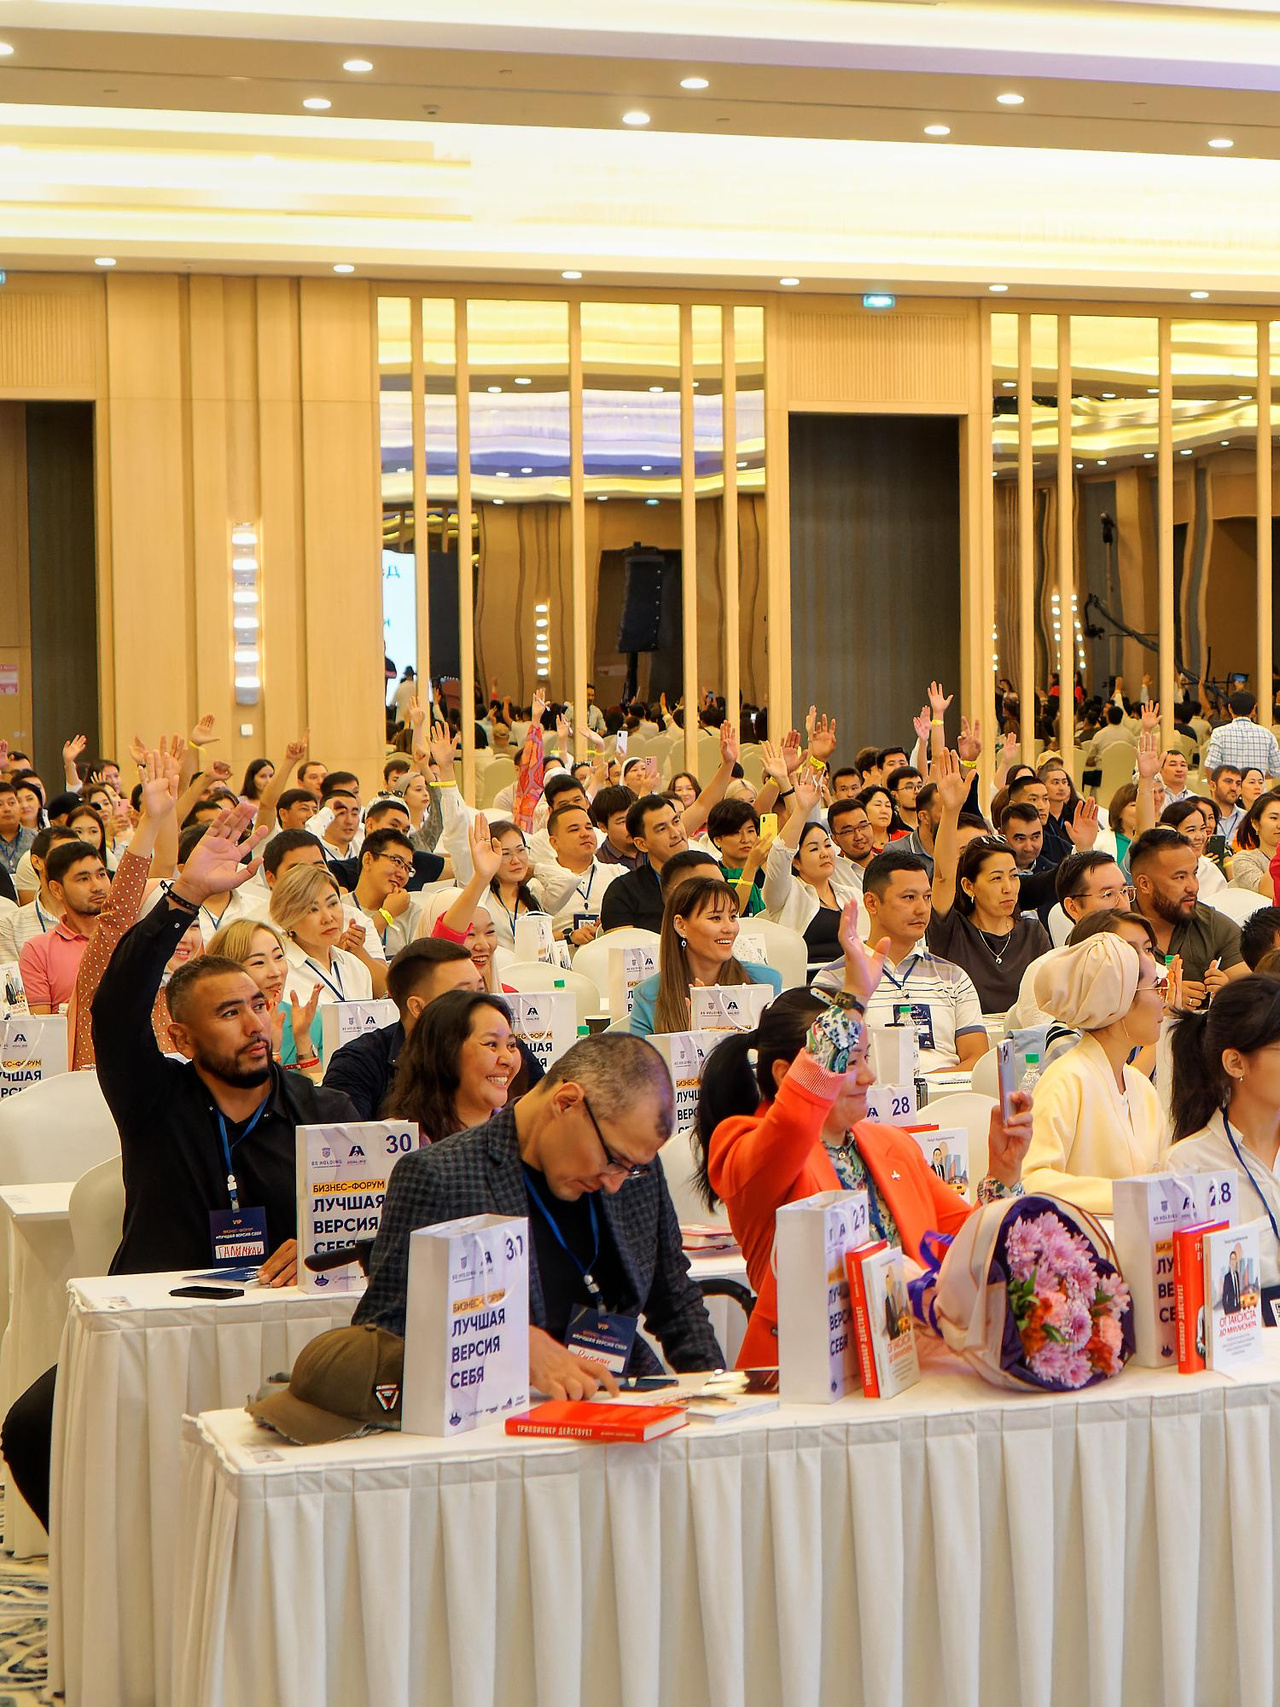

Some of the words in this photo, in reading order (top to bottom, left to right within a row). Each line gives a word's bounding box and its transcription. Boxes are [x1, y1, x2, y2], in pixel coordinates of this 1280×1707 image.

[891, 1096, 911, 1116] 28
[386, 1133, 412, 1154] 30
[313, 1181, 385, 1193] БИЗНЕС-ФОРУМ
[313, 1195, 385, 1213] ЛУЧШАЯ
[314, 1216, 379, 1235] ВЕРСИЯ
[452, 1308, 505, 1337] ЛУЧШАЯ
[452, 1336, 500, 1363] ВЕРСИЯ
[450, 1366, 484, 1389] СЕБЯ
